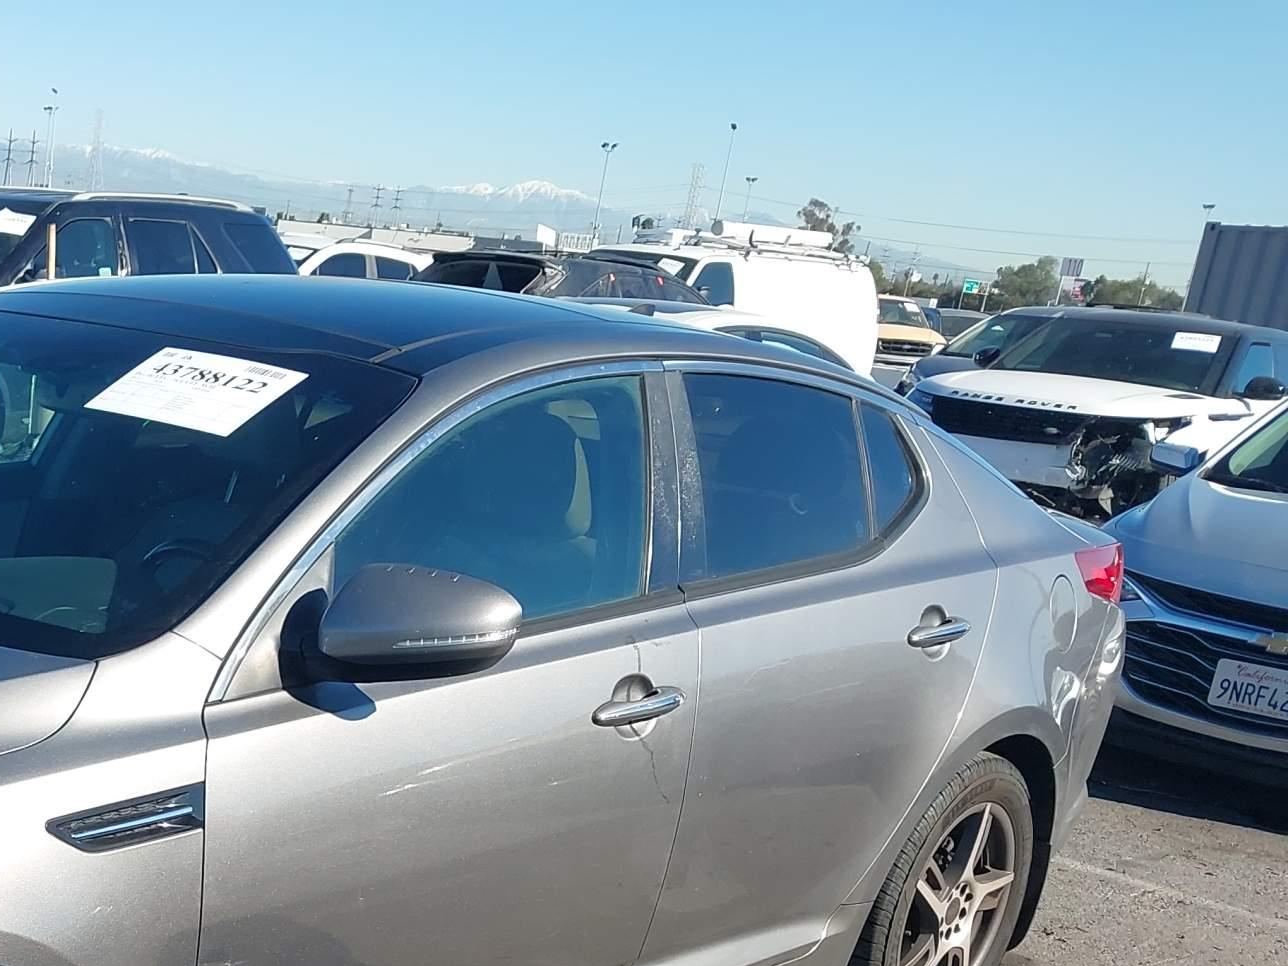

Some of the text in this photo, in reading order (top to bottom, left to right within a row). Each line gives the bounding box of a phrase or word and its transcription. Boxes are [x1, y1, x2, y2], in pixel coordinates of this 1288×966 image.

[153, 361, 269, 394] 43788122
[951, 390, 1079, 411] RANGE ROVER
